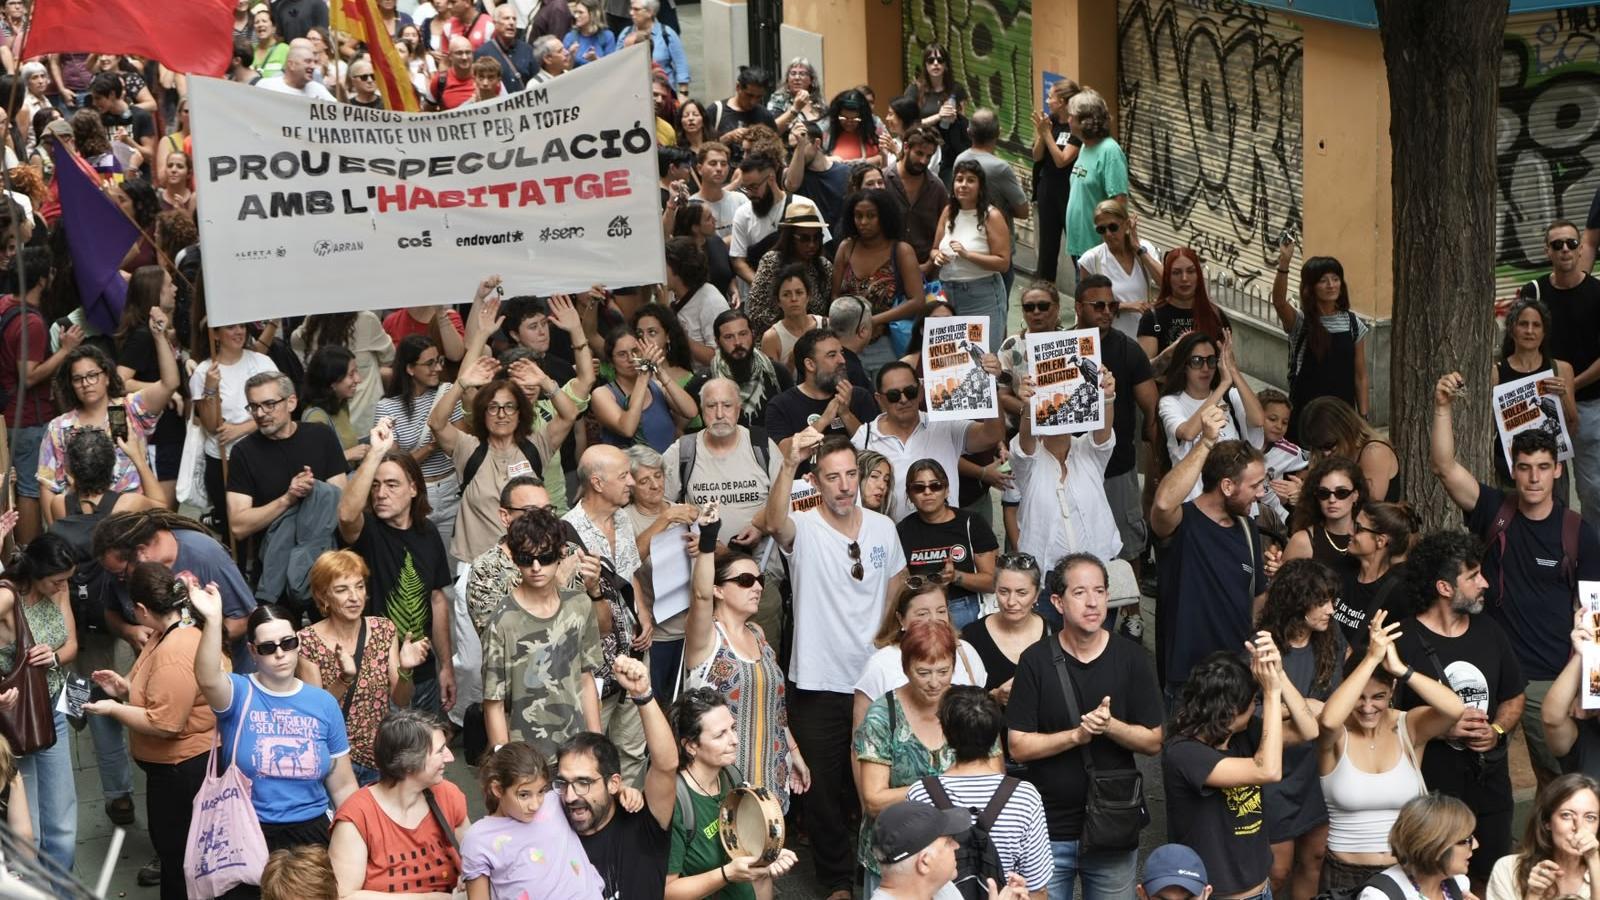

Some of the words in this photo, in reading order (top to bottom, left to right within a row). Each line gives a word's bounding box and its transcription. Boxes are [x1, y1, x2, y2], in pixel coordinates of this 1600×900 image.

[310, 103, 337, 120] ALS
[496, 88, 549, 112] FAREM
[282, 126, 303, 139] DE
[308, 126, 404, 144] L'HABITATGE
[408, 126, 432, 143] UN
[437, 122, 477, 142] DRET
[483, 117, 514, 137] PER
[519, 114, 530, 132] A
[533, 106, 580, 130] TOTES
[208, 150, 330, 182] PROU
[338, 120, 652, 180] ESPECULACIÓ
[237, 188, 335, 220] AMB
[341, 169, 632, 214] L'HABITATGE
[333, 240, 364, 253] ARRAN
[456, 231, 511, 247] endavant
[930, 328, 935, 336] NI
[936, 326, 946, 335] FONS
[948, 322, 967, 332] VOLTORS
[929, 336, 934, 344] NI
[1034, 344, 1040, 353] NI
[1041, 342, 1054, 352] FONS
[1056, 337, 1078, 348] VOLTORS
[929, 342, 956, 358] VOLEM
[1034, 353, 1041, 361] NI
[930, 352, 969, 369] HABITATGE!
[1036, 358, 1066, 374] VOLEM
[1038, 368, 1078, 386] HABITATGE!
[1504, 390, 1516, 400] FONS
[1516, 381, 1535, 394] VOLTORS
[1502, 401, 1528, 419] VOLEM
[1504, 407, 1540, 431] HABITATGE!
[692, 482, 720, 492] HUELGA
[722, 482, 732, 490] DE
[733, 480, 758, 490] PAGAR
[694, 495, 708, 504] LOS
[910, 550, 948, 561] PALMA
[256, 722, 274, 734] SER
